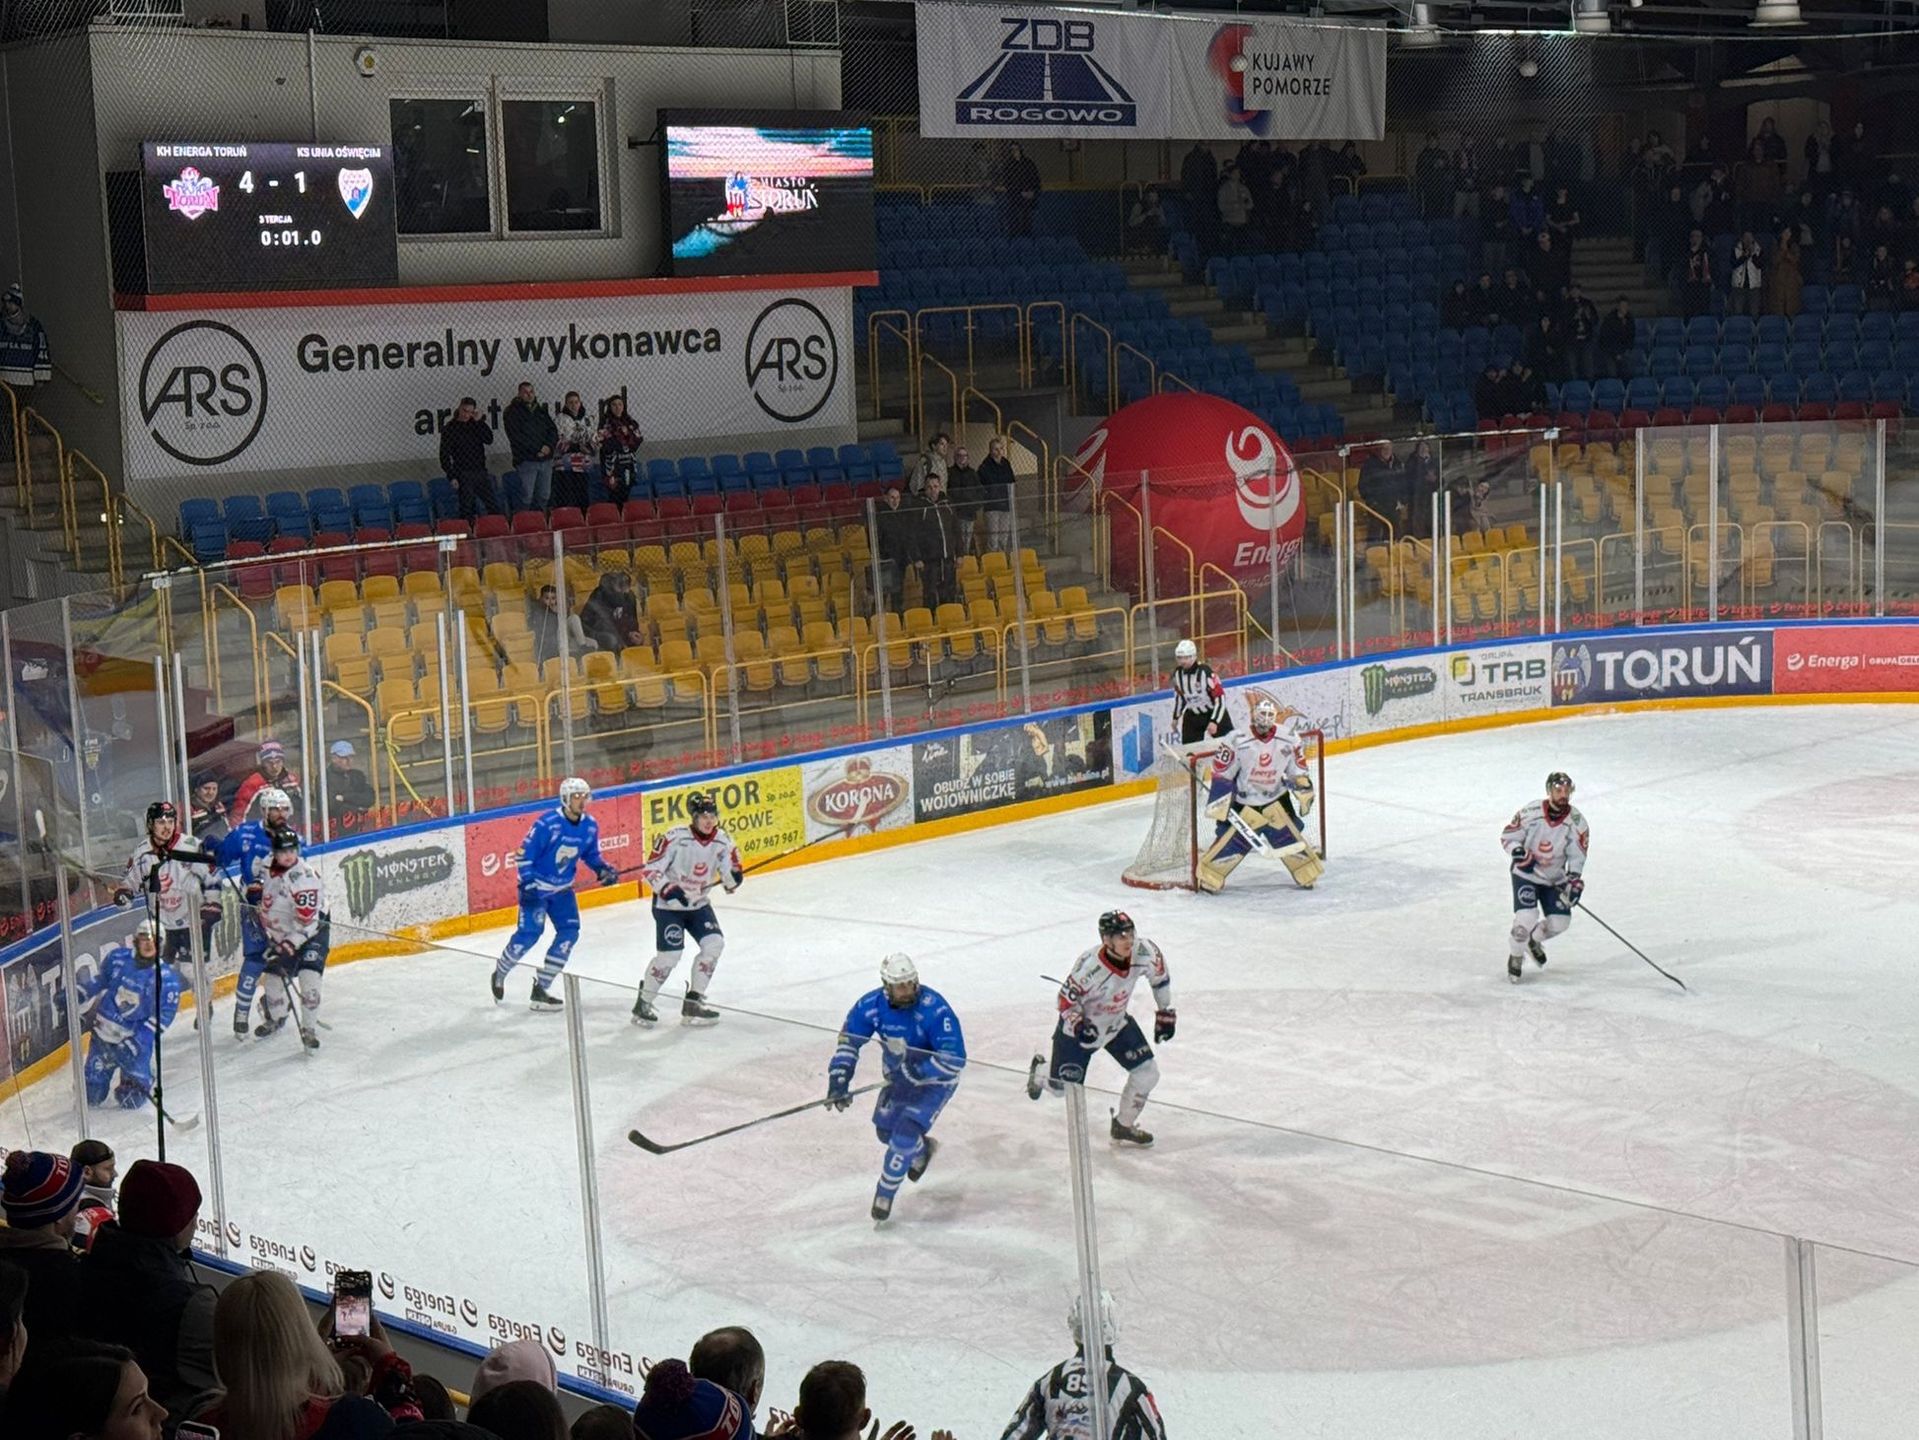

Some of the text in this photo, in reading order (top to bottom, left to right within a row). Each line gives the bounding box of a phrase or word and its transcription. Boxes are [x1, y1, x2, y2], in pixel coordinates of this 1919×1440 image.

[1001, 17, 1095, 52] ZDB
[1252, 53, 1315, 72] KUJAWY
[1252, 77, 1331, 96] POMORZE
[969, 107, 1123, 123] ROGOWO
[156, 145, 247, 158] KH ENERGA TORUŃ
[297, 146, 381, 160] KS UNIA OŚWIĘCIM
[239, 170, 254, 193] 4
[294, 171, 306, 194] 1
[261, 230, 322, 246] 0:01.0
[297, 323, 722, 377] Generalny wykonawca
[752, 334, 828, 390] ARS
[147, 363, 253, 426] ARS
[1482, 659, 1546, 684] TRB
[1596, 636, 1762, 691] TORUŃ
[1807, 654, 1859, 671] Energa
[1460, 685, 1542, 703] TRANSBRUK
[971, 774, 983, 788] W
[984, 768, 1016, 786] SOBIE
[825, 783, 895, 812] KORONA
[920, 782, 1017, 813] WOJOWNICZKĘ
[376, 854, 448, 879] MONSTER
[943, 1017, 952, 1032] 6
[889, 1154, 904, 1171] 6
